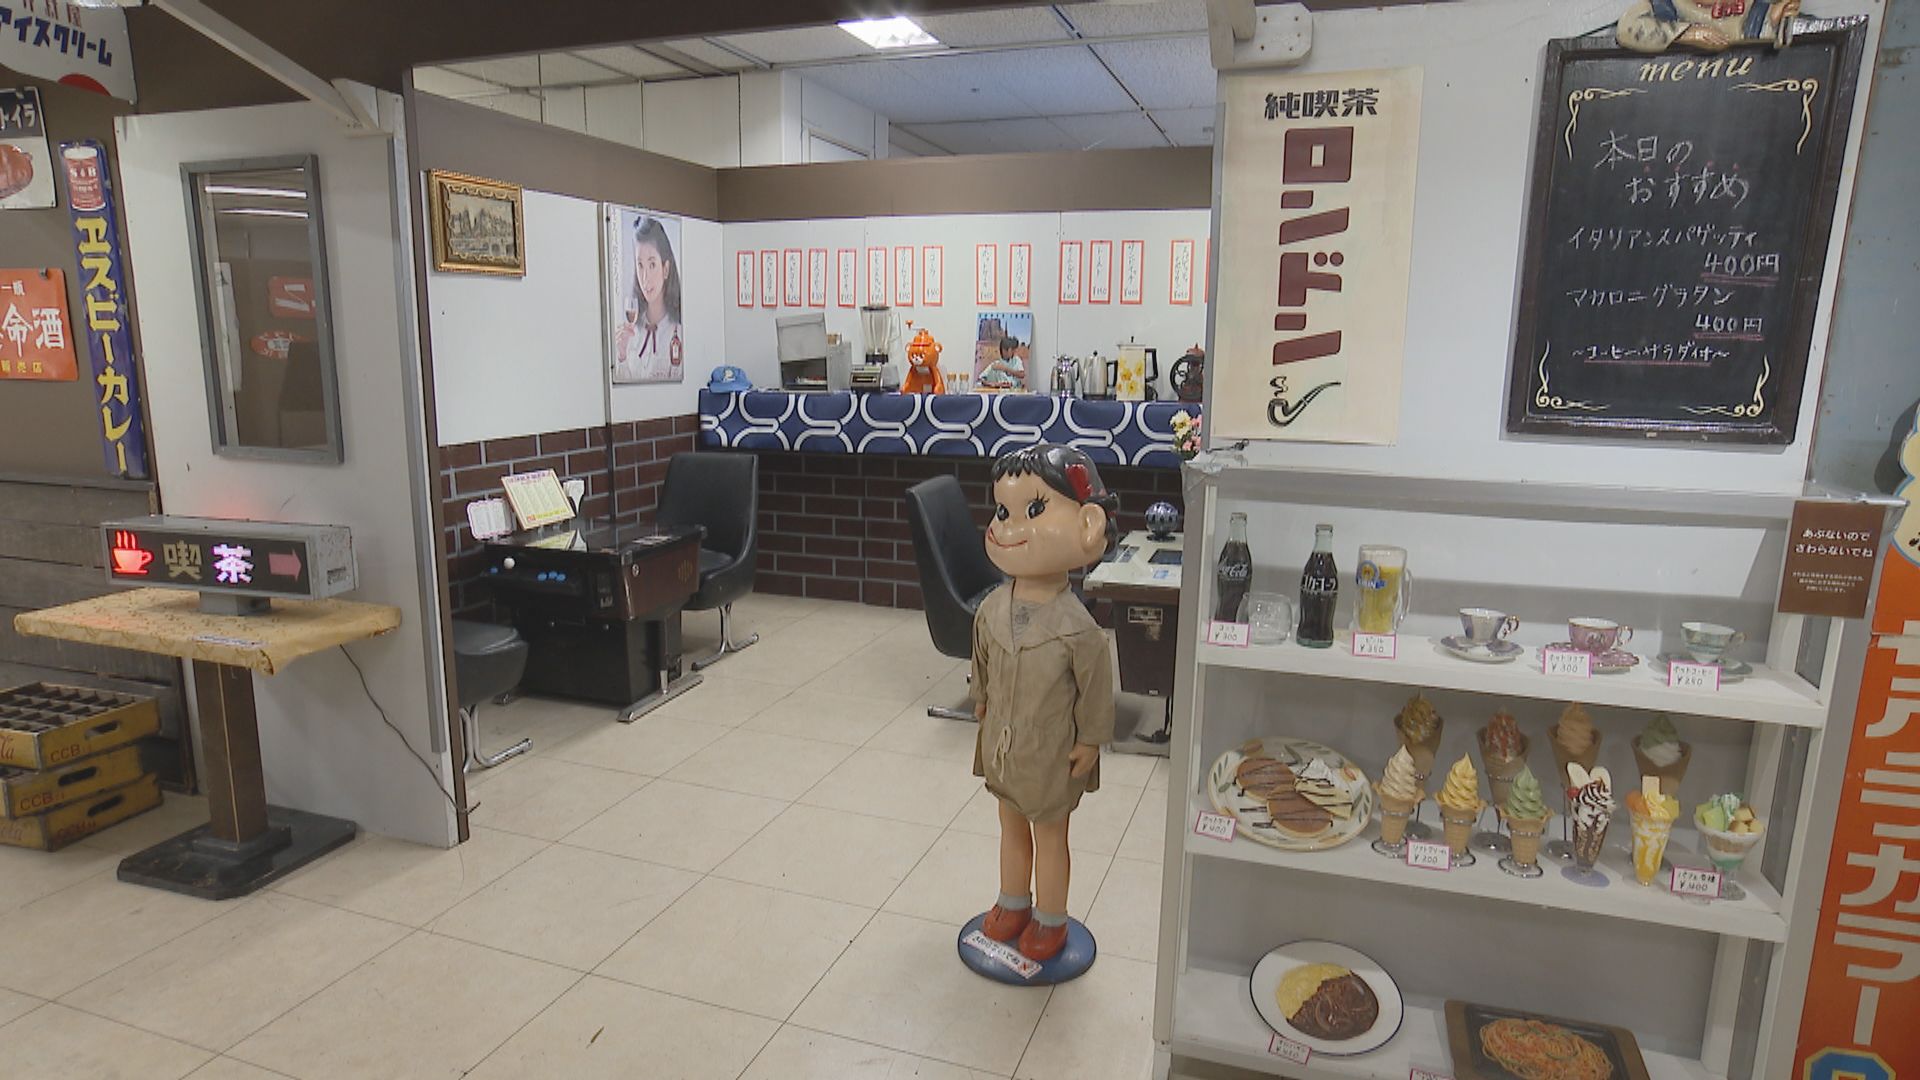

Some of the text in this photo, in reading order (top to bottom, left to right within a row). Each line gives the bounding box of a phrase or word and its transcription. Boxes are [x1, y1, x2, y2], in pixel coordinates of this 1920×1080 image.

[1639, 56, 1754, 83] menu
[1265, 88, 1380, 120] 純喫茶
[1594, 130, 1694, 171] 本日の
[1626, 167, 1751, 209] おすすめ
[1272, 126, 1354, 366] ロンドン
[1704, 251, 1780, 276] 400円
[1566, 283, 1736, 307] マカロニグラタン
[0, 302, 64, 358] 命酒
[1695, 313, 1763, 333] 400円
[74, 216, 132, 474] エスビーカレー
[1802, 528, 1871, 541] あぶないので
[162, 539, 255, 584] 喫茶
[1795, 543, 1873, 557] さわらないでね
[50, 743, 81, 763] CCB
